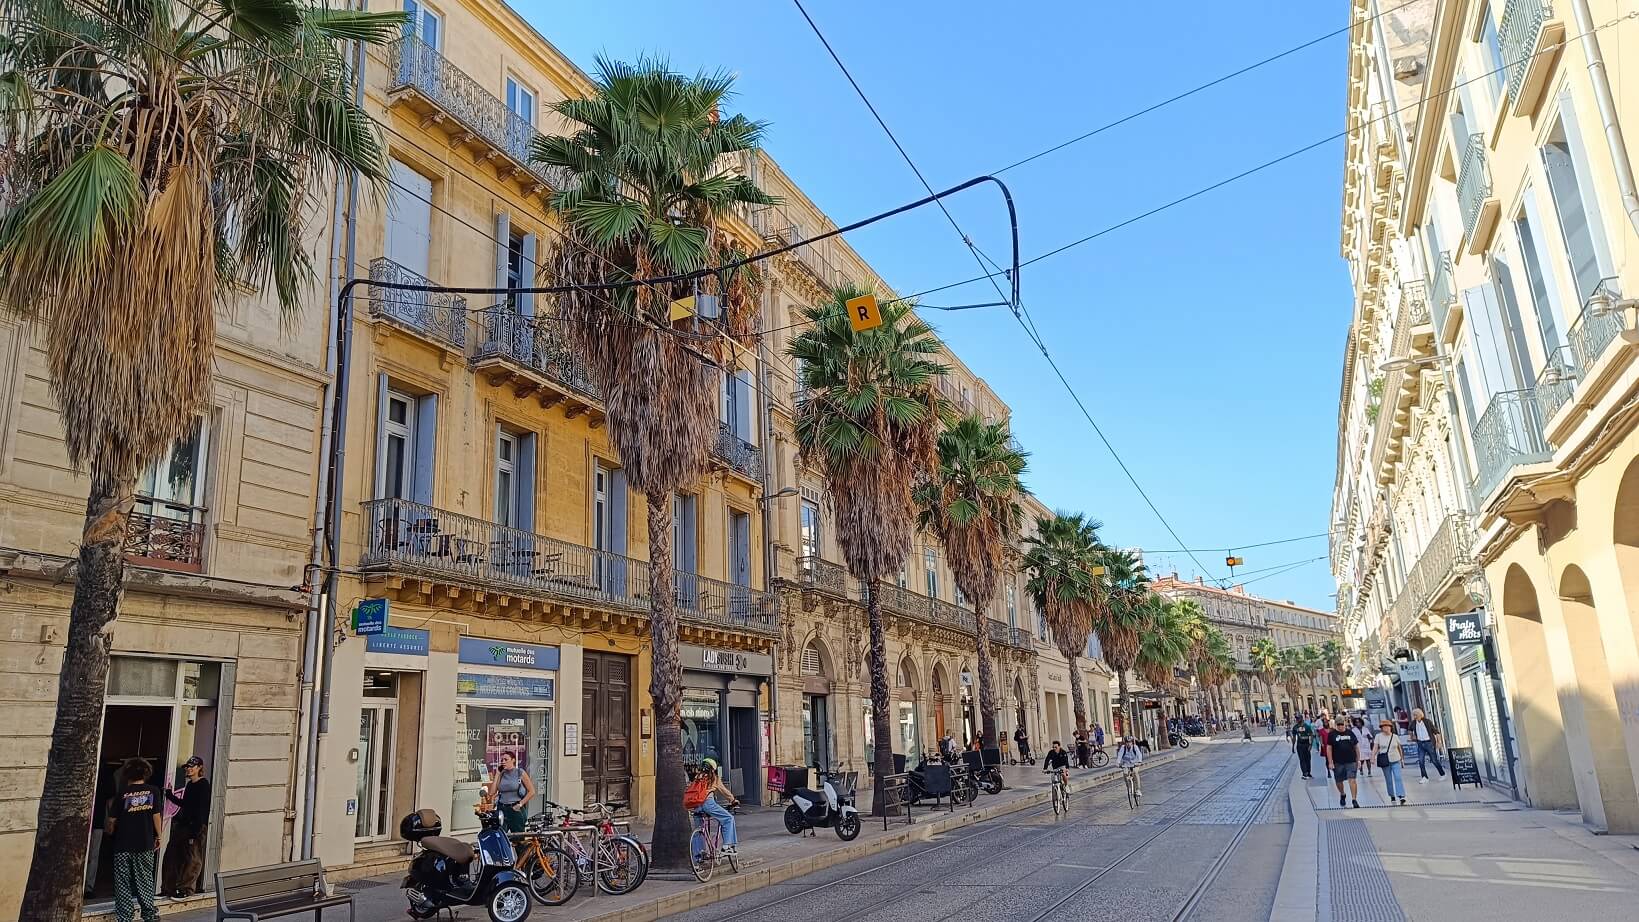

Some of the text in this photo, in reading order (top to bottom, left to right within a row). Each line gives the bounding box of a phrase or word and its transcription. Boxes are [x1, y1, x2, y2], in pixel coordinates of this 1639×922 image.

[857, 306, 870, 321] R
[357, 625, 382, 633] motards
[1449, 619, 1475, 632] grain
[506, 654, 535, 665] motards
